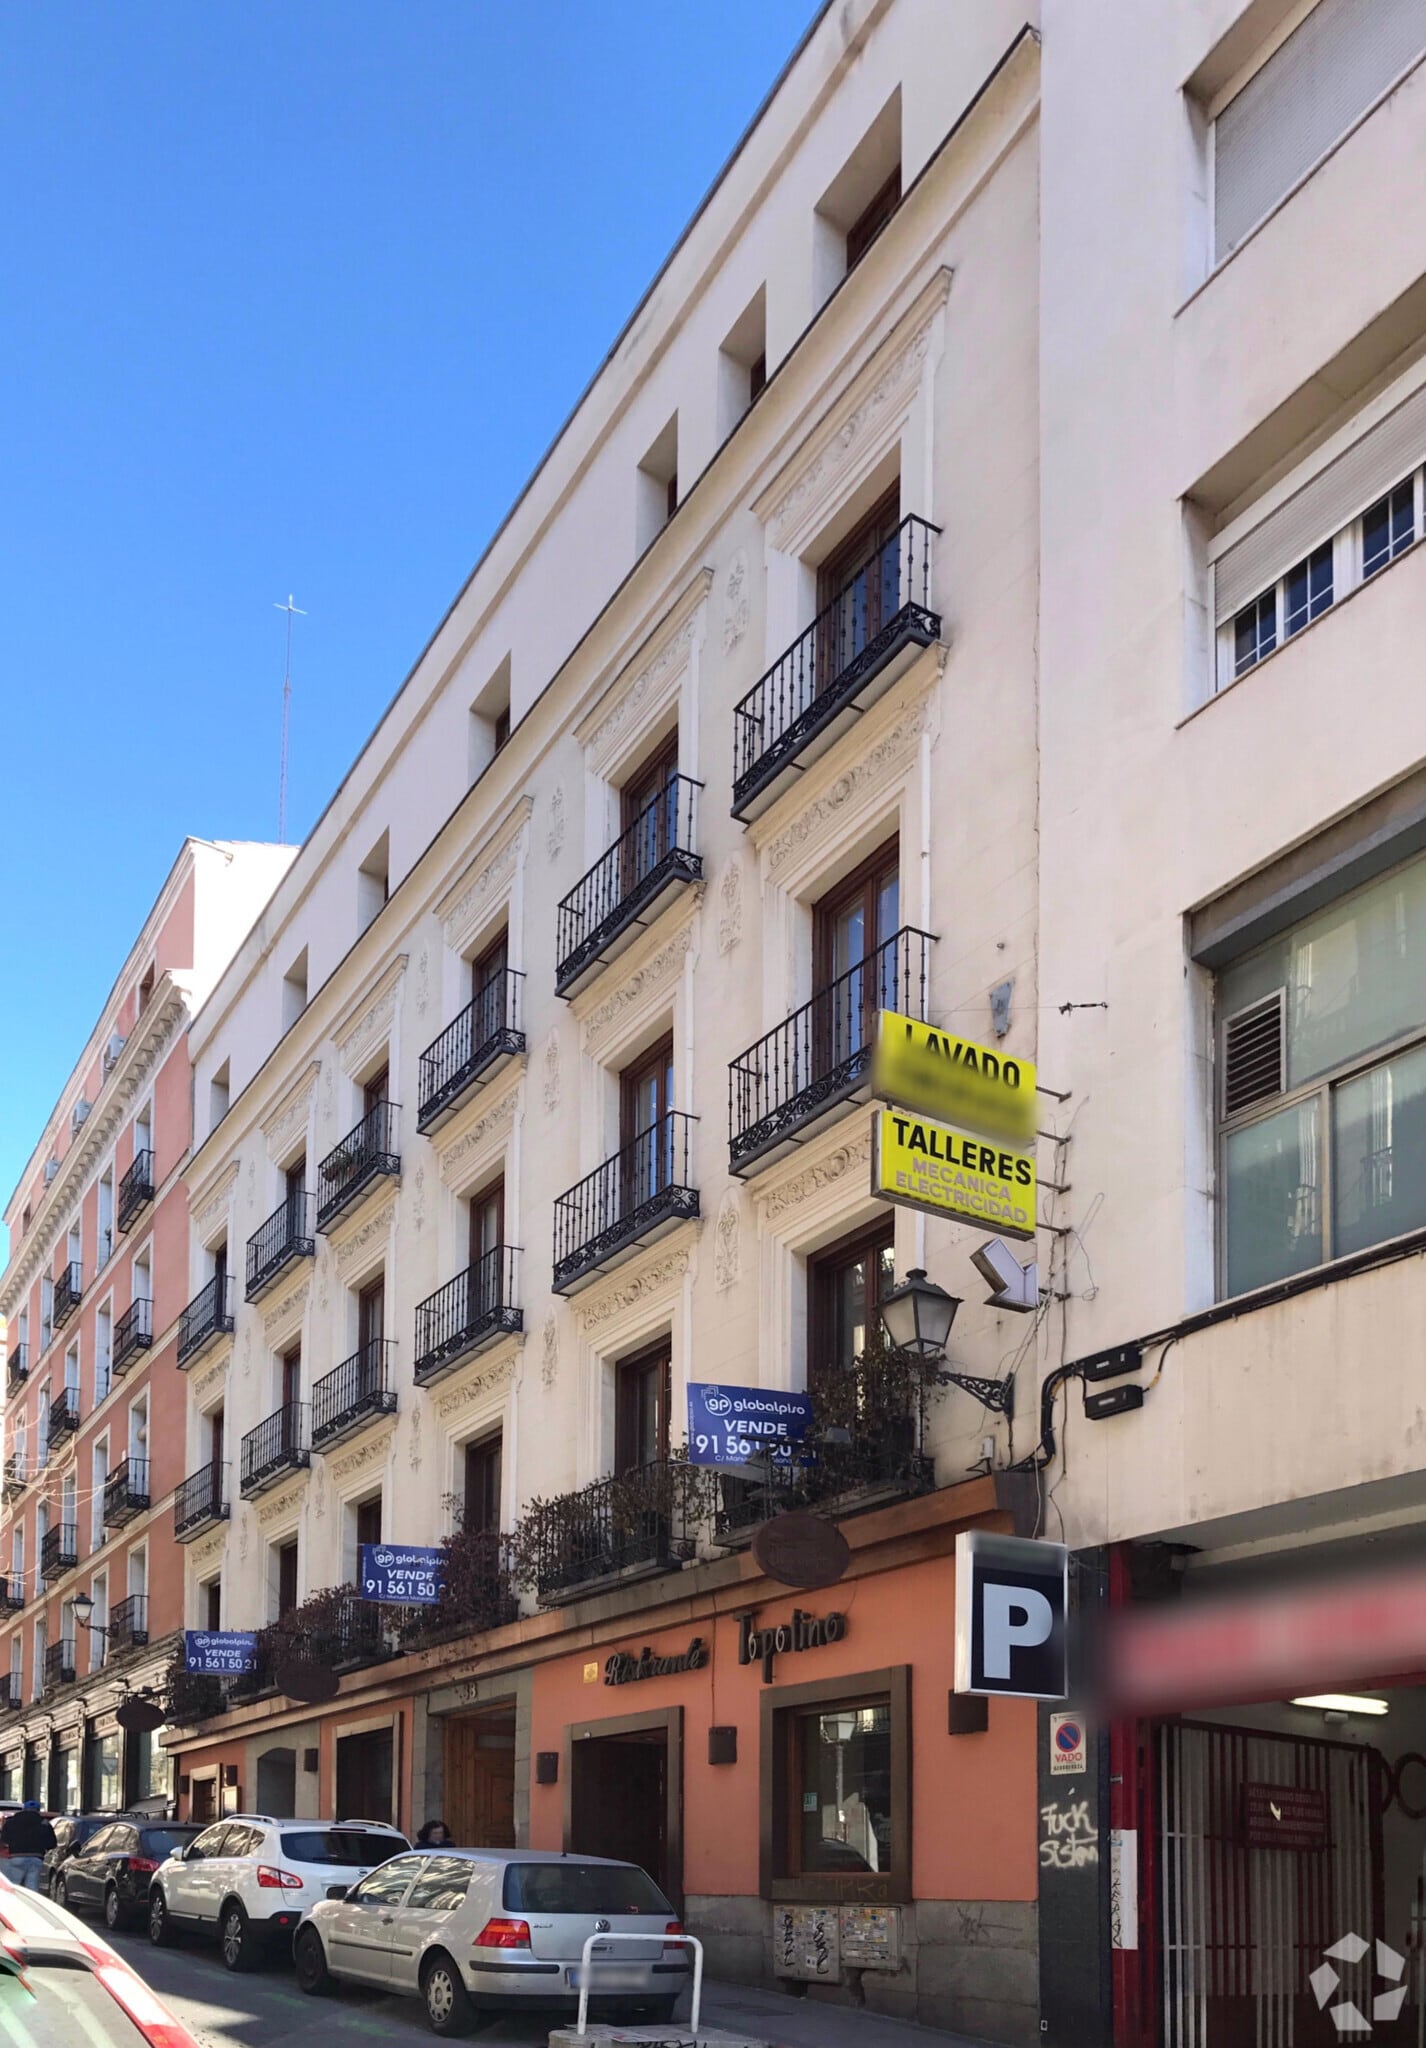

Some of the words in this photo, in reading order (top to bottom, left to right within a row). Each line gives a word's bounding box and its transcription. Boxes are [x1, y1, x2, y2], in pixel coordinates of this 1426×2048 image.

[892, 1117, 1031, 1185] TALLERES
[912, 1157, 1011, 1201] MECANICA
[895, 1170, 1027, 1223] ELECTRICIDAD
[708, 1398, 729, 1411] gp
[733, 1399, 805, 1415] globalpiso
[724, 1419, 787, 1435] VENDE
[696, 1435, 718, 1454] 91
[387, 1569, 434, 1580] VENDE
[366, 1579, 382, 1593] 91
[387, 1581, 412, 1595] 561
[417, 1582, 435, 1596] 50
[983, 1583, 1053, 1679] P
[205, 1649, 241, 1657] VENDE
[731, 1608, 848, 1683] Topolino
[189, 1656, 202, 1667] 91
[205, 1657, 225, 1668] 561
[228, 1658, 242, 1669] 50
[244, 1658, 257, 1669] 21
[1055, 1752, 1082, 1763] VADO
